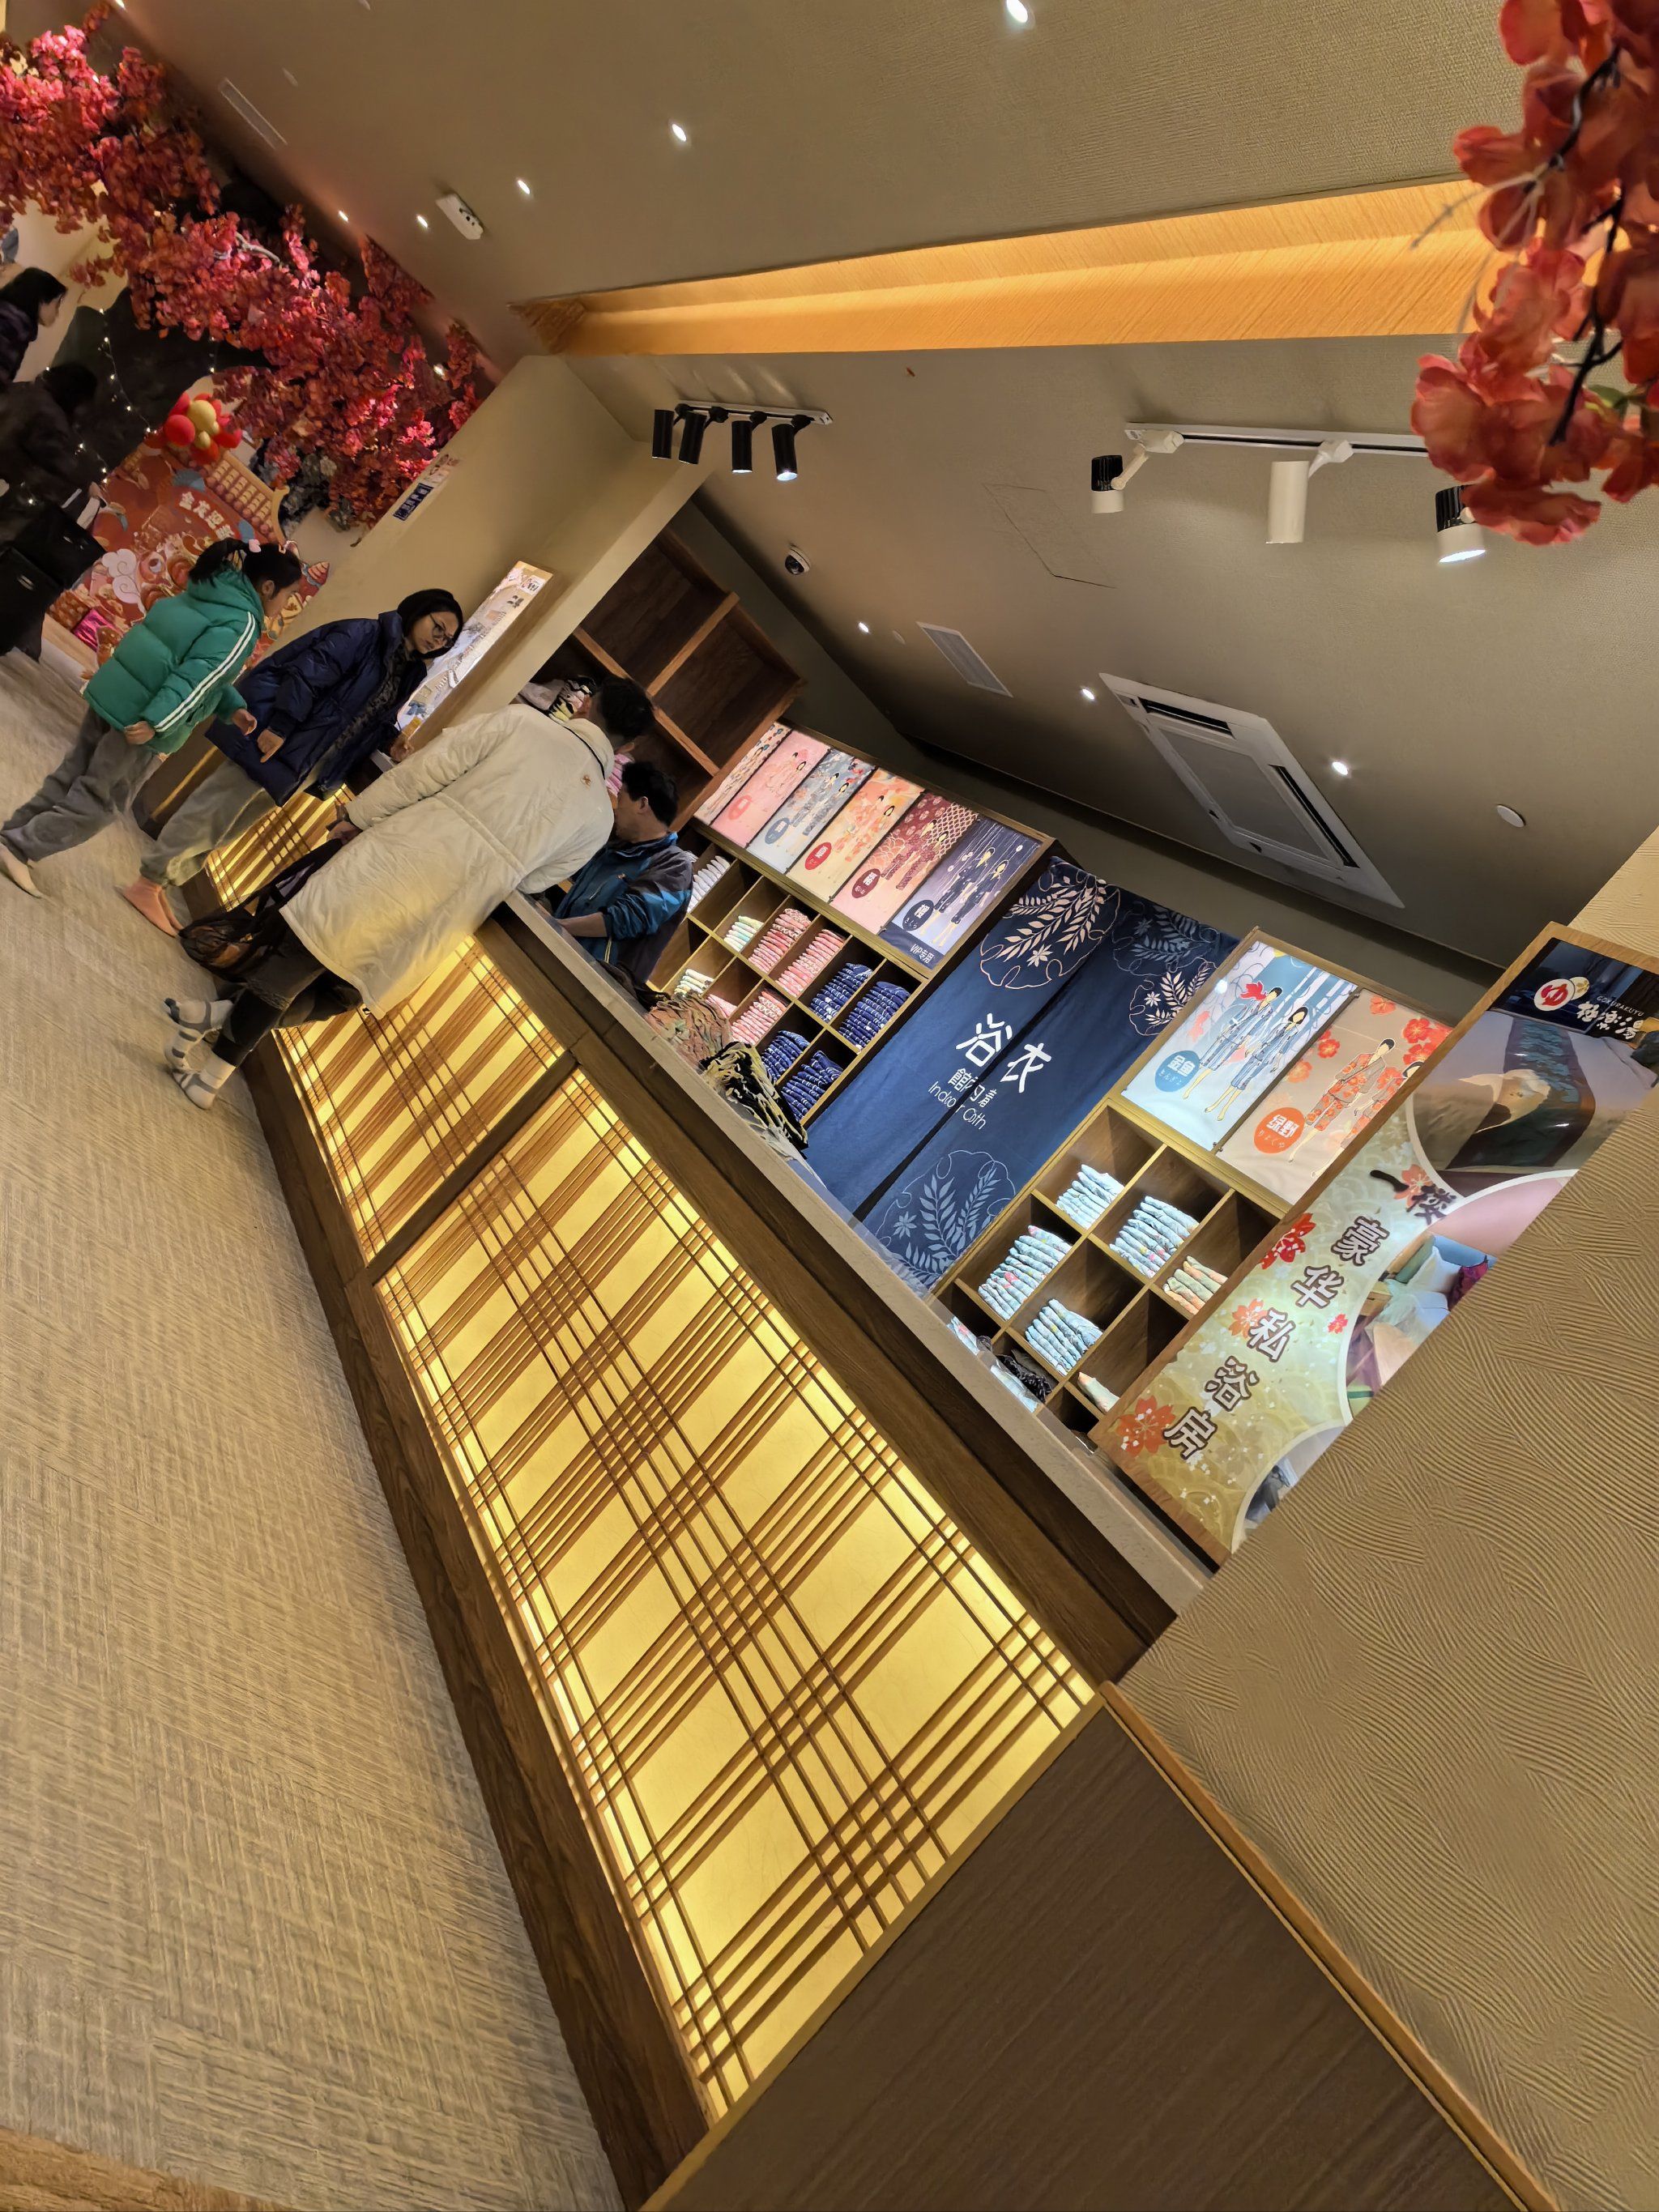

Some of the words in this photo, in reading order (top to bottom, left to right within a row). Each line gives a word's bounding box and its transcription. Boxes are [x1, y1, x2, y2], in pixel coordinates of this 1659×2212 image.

[910, 944, 935, 964] VIP专用
[1596, 995, 1645, 1016] GOKURAKUYU
[955, 1012, 1052, 1093] 浴衣
[928, 1080, 966, 1114] Indoor
[1265, 1114, 1300, 1138] 绿野
[1369, 1170, 1457, 1226] 一楼
[1163, 1216, 1390, 1459] 豪华私浴房
